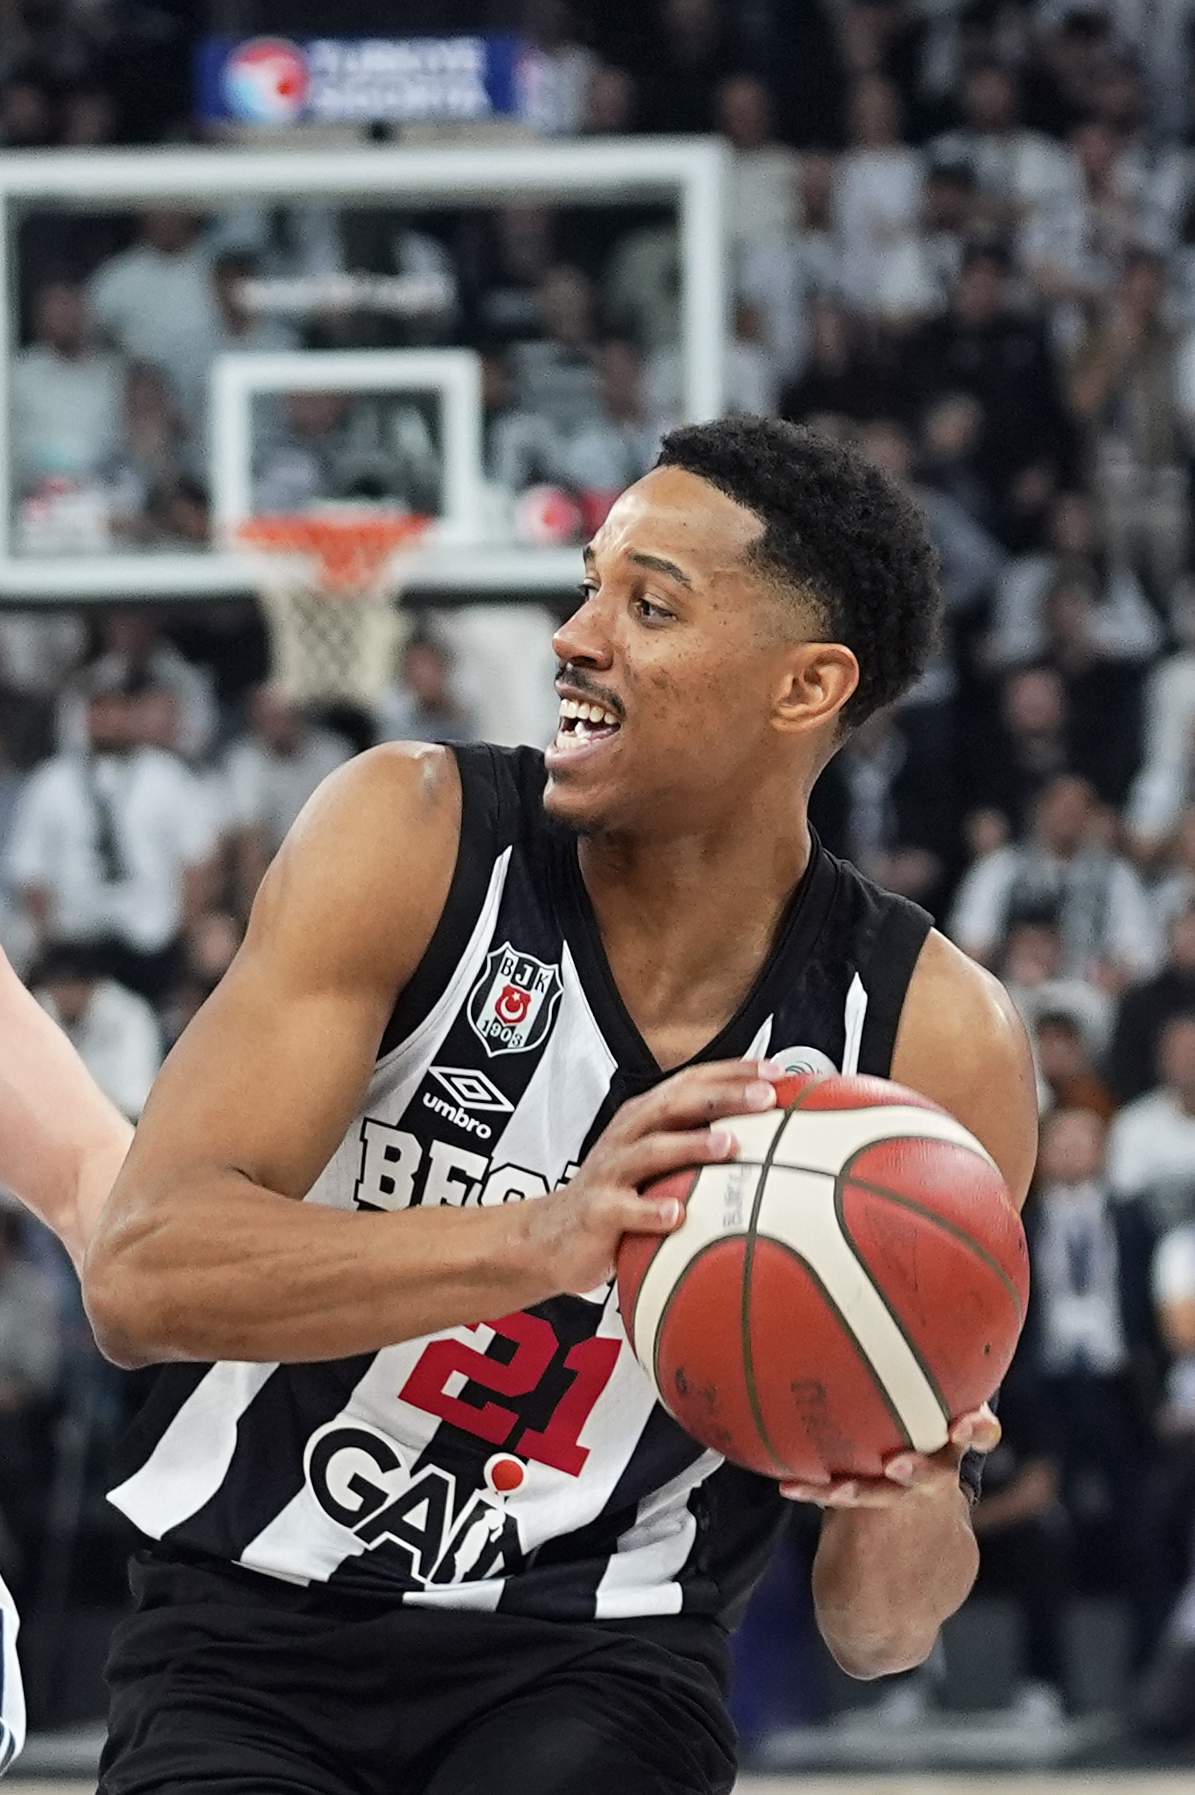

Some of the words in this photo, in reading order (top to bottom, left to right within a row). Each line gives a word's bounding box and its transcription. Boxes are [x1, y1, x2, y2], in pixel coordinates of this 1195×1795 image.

[501, 957, 549, 993] BJK
[422, 1092, 492, 1139] umbro
[397, 1311, 623, 1478] 21
